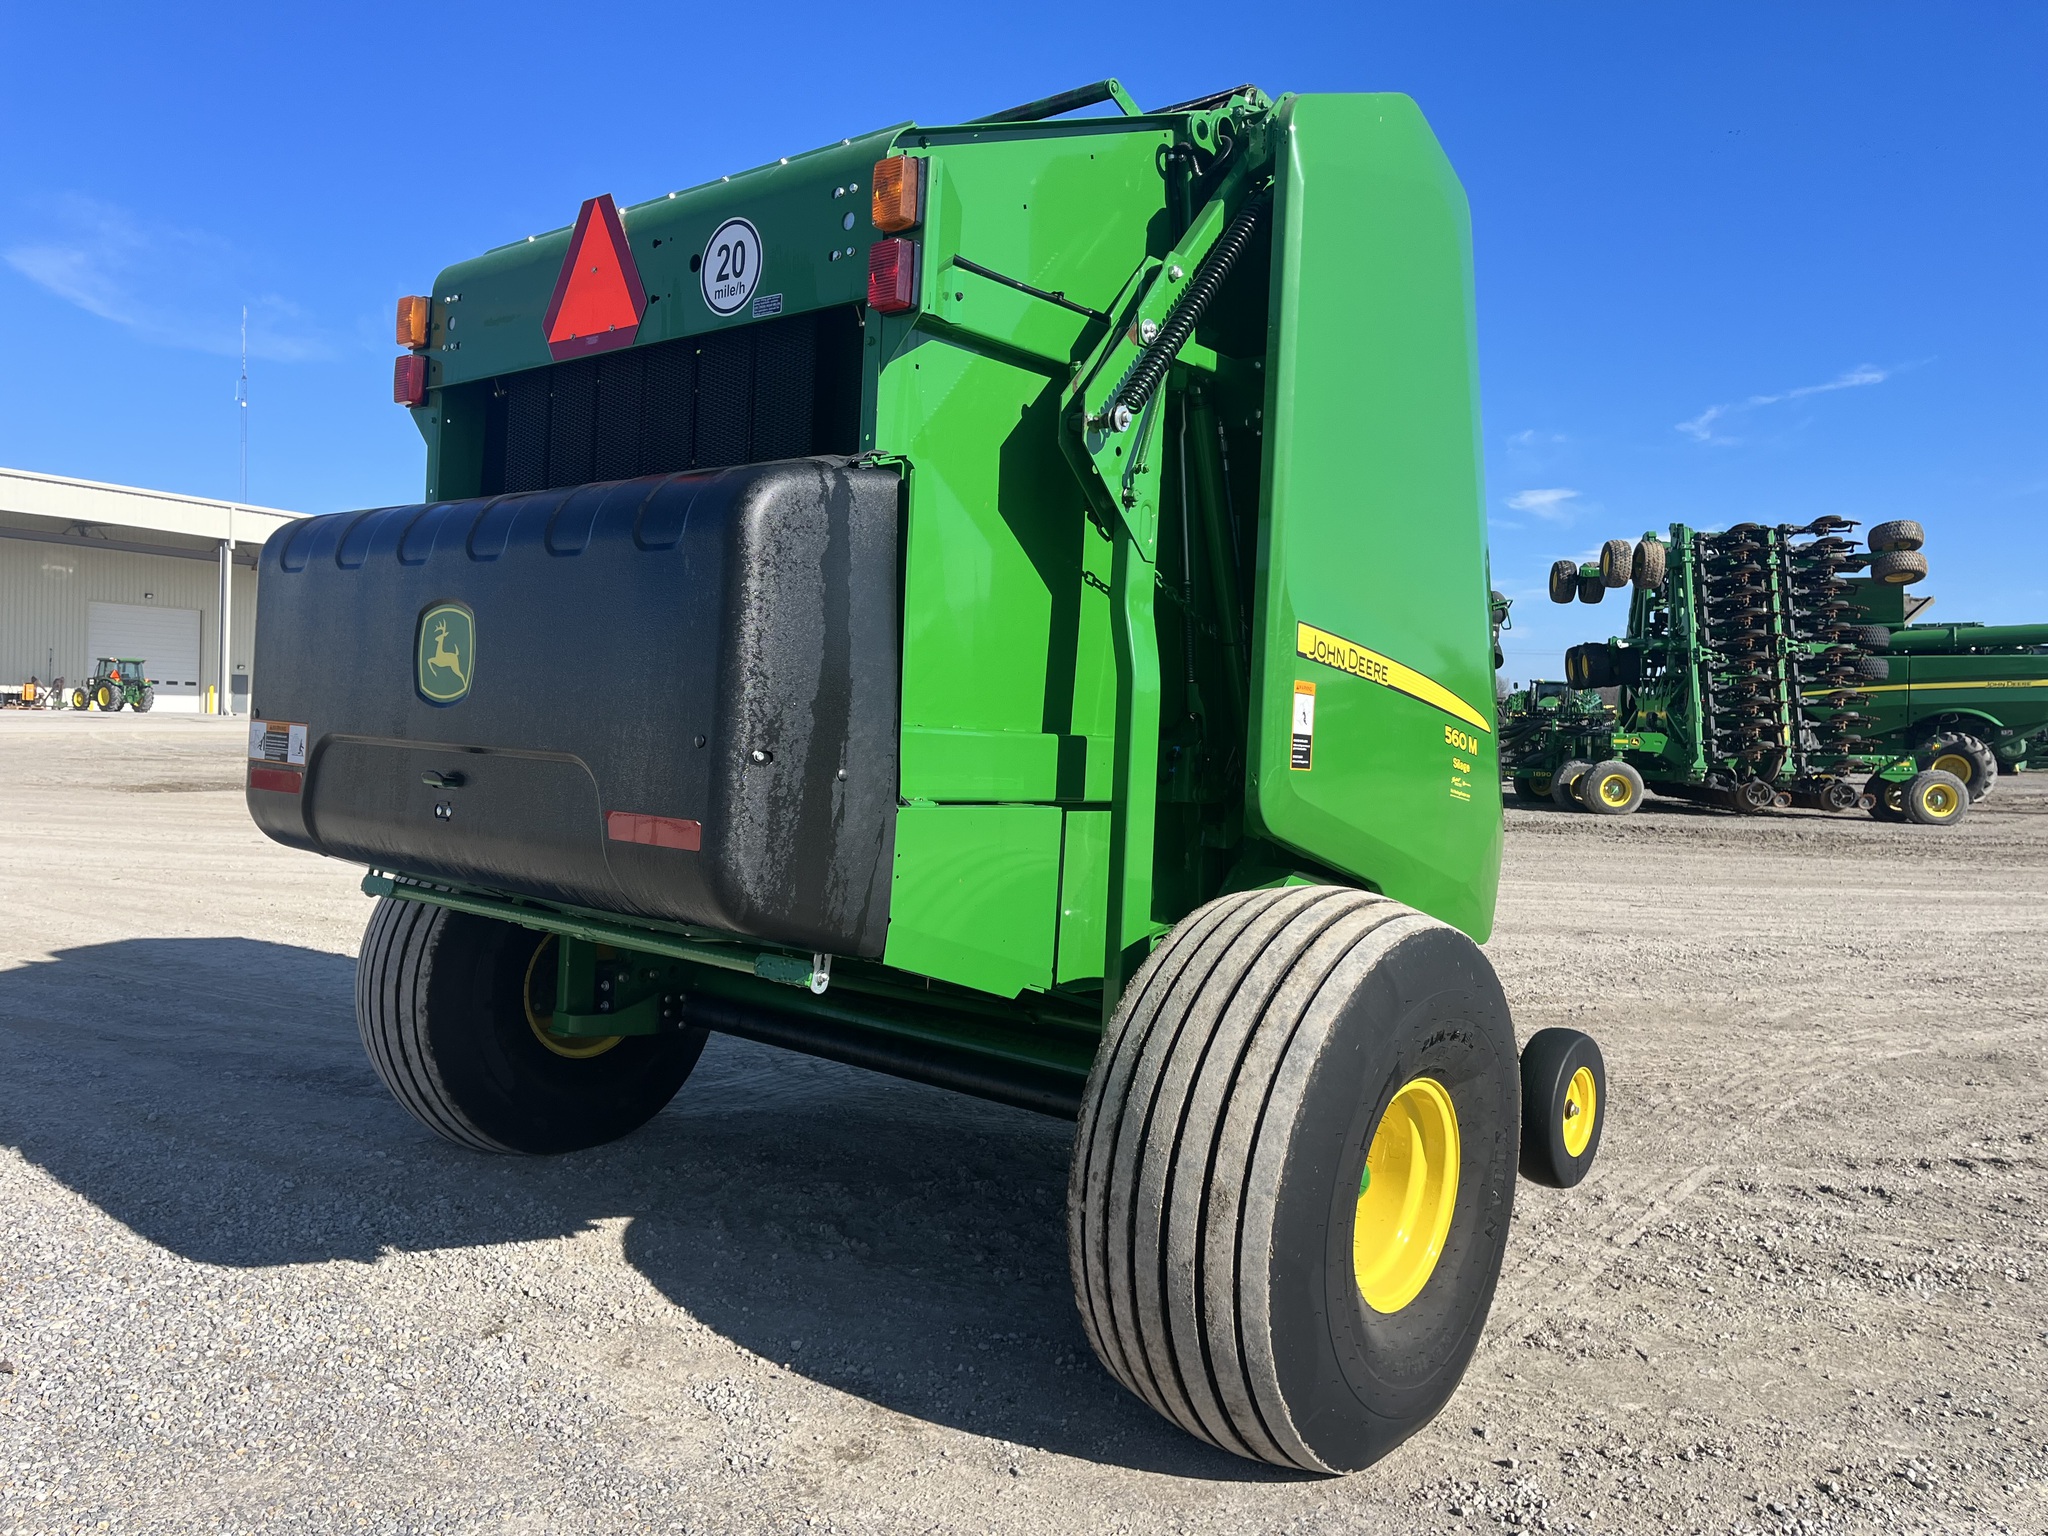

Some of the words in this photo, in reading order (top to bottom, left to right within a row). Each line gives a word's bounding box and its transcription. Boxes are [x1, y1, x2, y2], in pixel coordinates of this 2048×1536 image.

[716, 239, 746, 283] 20
[714, 282, 746, 300] mile/h
[1308, 634, 1346, 667] JOHN
[1348, 647, 1389, 683] DEERE
[2006, 680, 2032, 688] DEERE
[1444, 724, 1467, 751] 560
[1468, 735, 1478, 756] M
[1452, 757, 1471, 774] Silage
